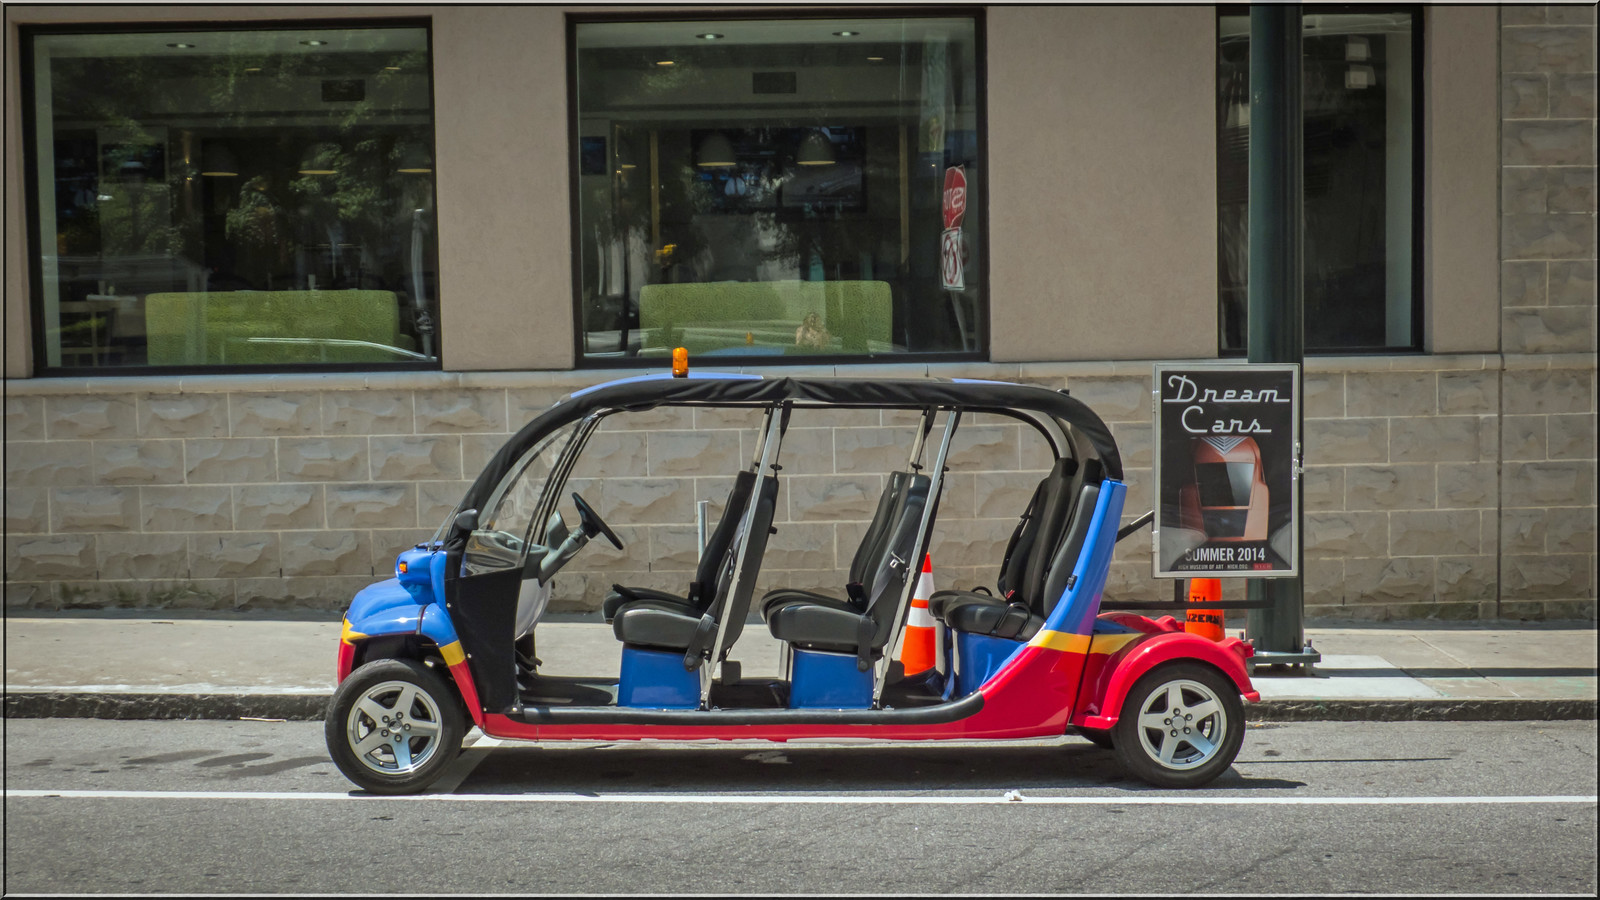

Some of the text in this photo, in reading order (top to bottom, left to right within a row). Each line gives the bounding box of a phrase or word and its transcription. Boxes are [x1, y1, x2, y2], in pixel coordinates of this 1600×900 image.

[1163, 375, 1290, 402] Dream
[1181, 405, 1272, 433] Cars
[1185, 547, 1266, 561] SUMMER 2014
